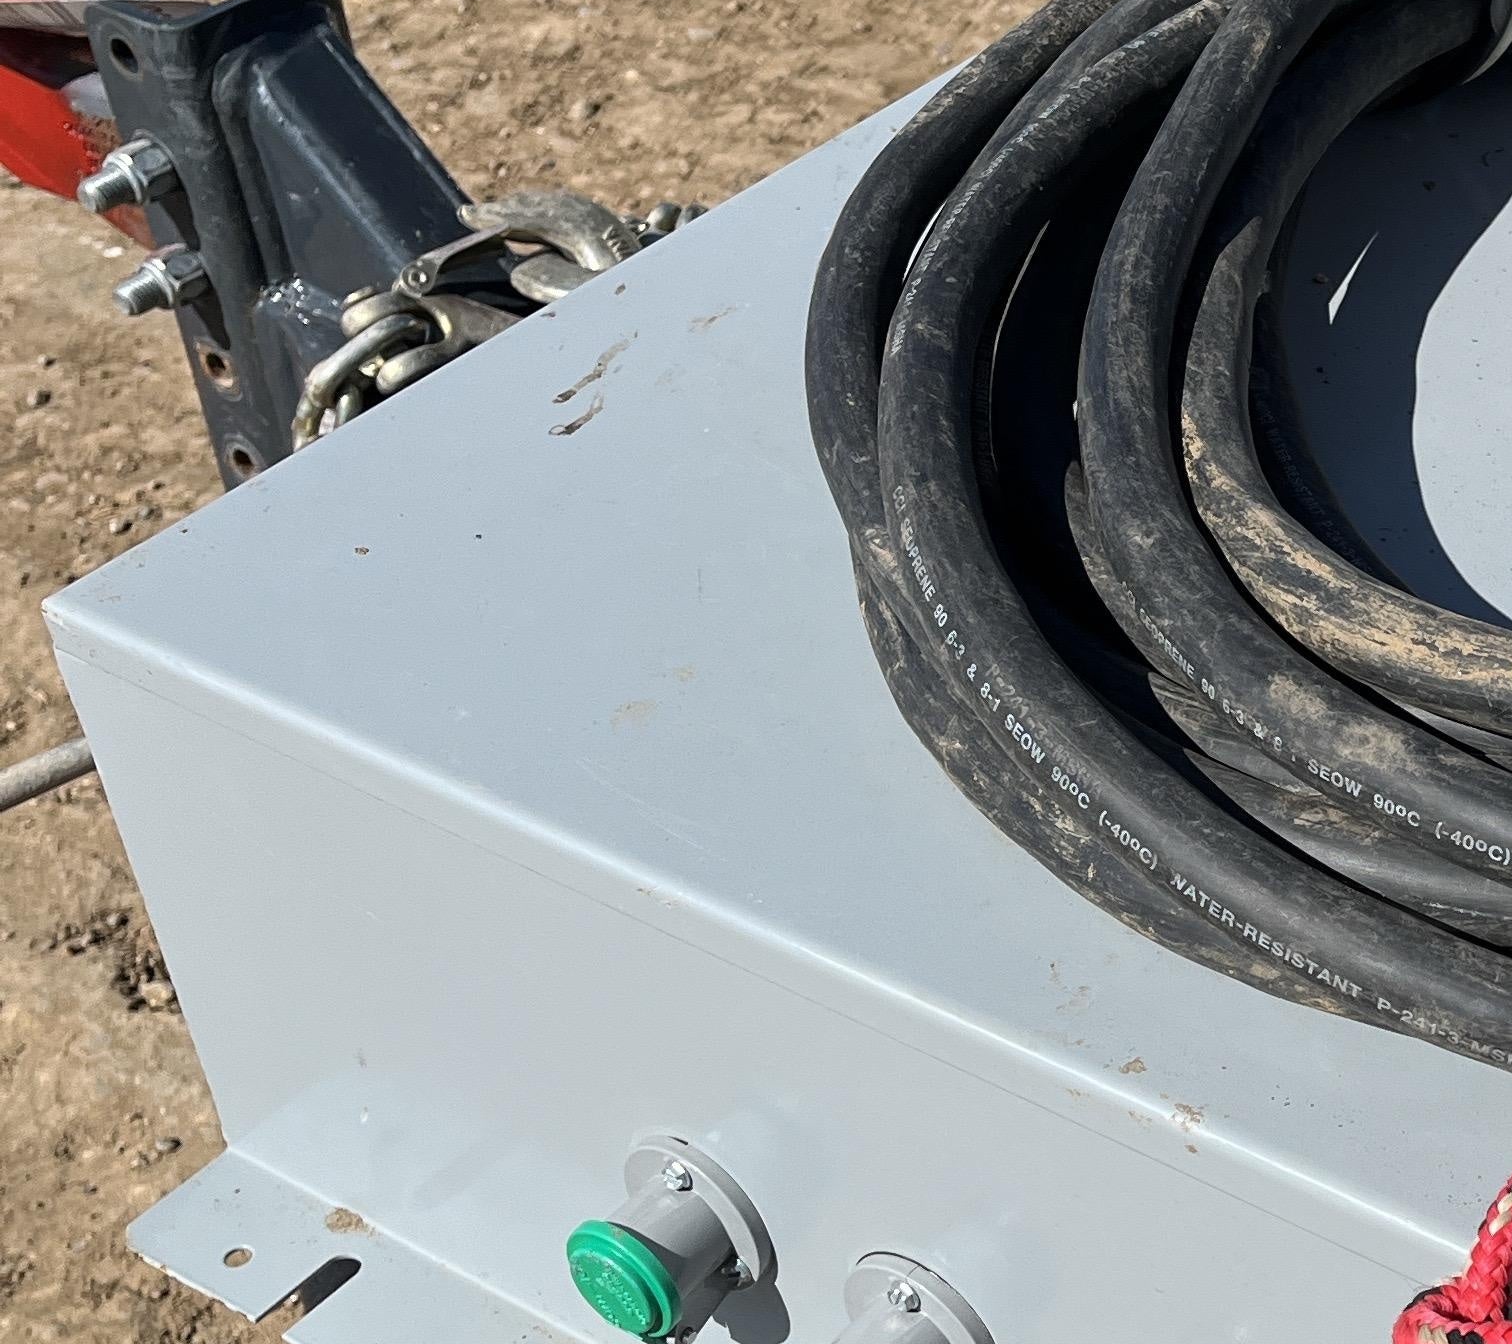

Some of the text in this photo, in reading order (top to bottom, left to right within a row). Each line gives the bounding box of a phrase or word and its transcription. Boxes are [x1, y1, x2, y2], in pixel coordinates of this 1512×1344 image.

[900, 517, 937, 603] SEOPRENE
[932, 603, 949, 629] 90
[944, 629, 967, 662] 6-3
[966, 661, 979, 681] &
[979, 682, 1002, 714] 8-1
[1004, 713, 1047, 765] SEOW
[1200, 677, 1216, 700] 90
[1221, 698, 1246, 726] 6-3
[1306, 757, 1363, 798] SEOW
